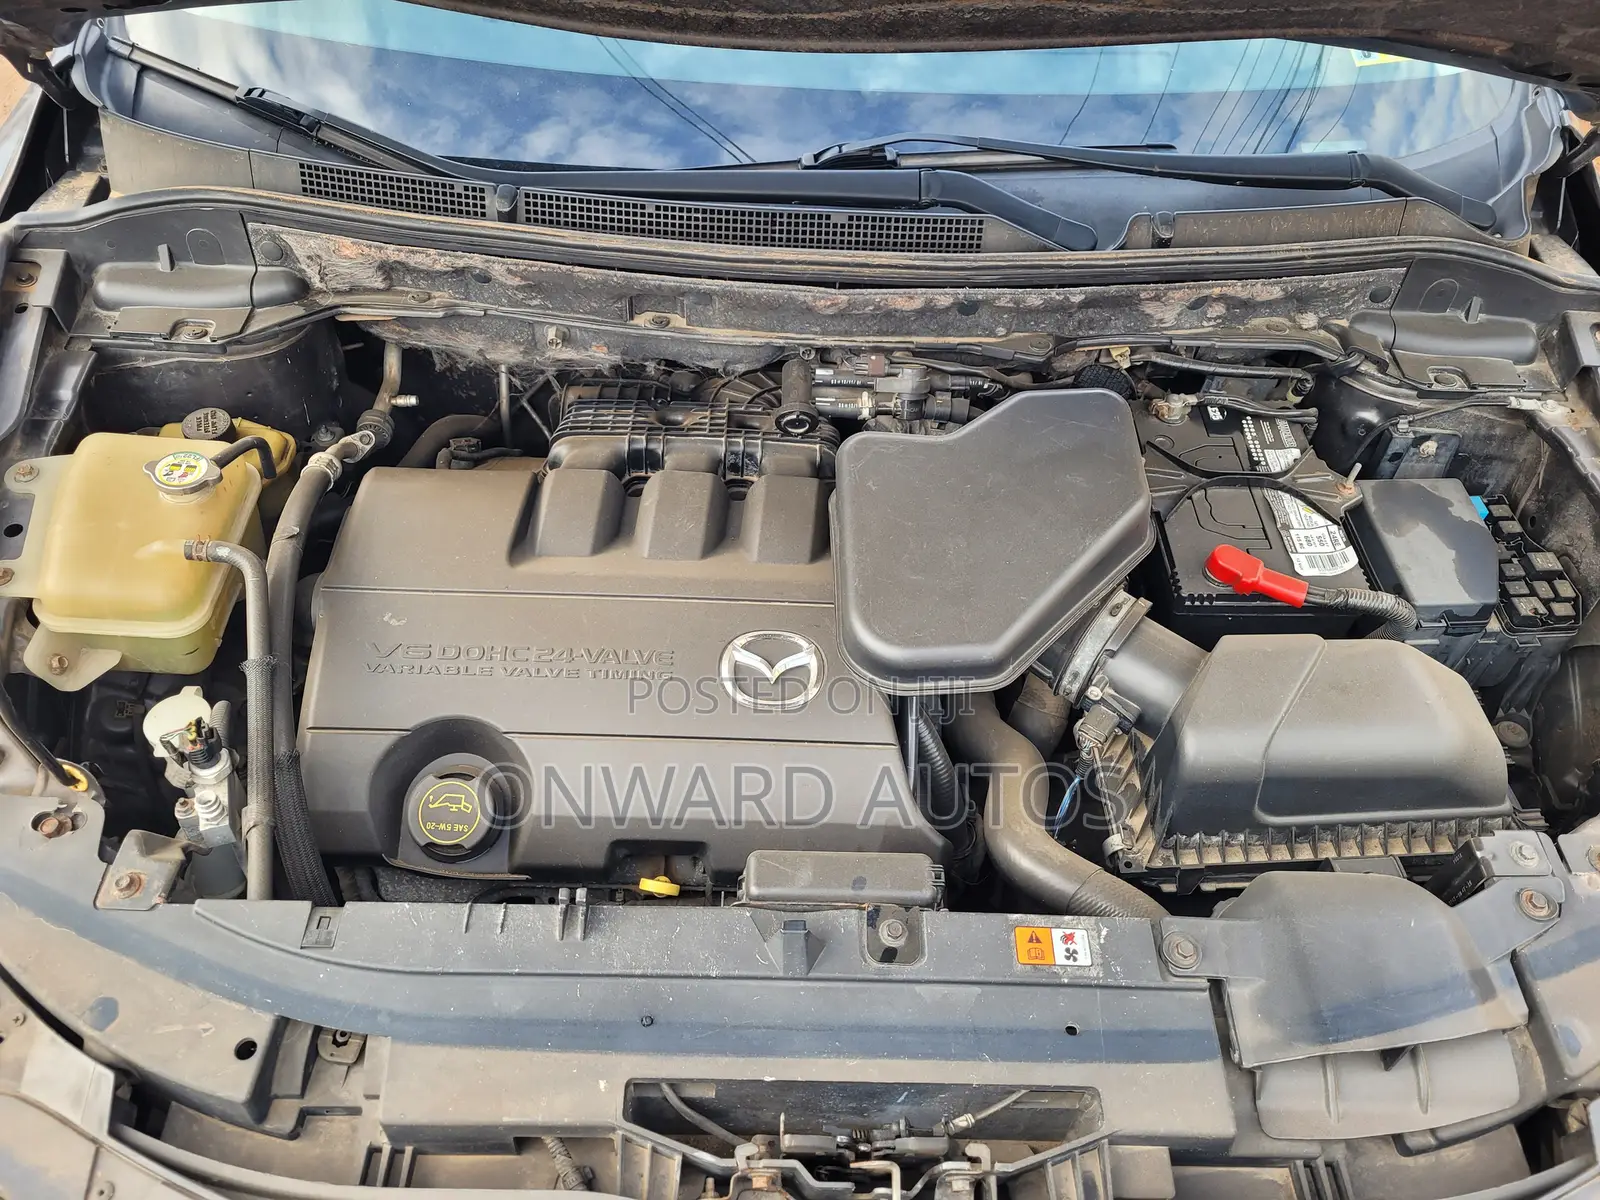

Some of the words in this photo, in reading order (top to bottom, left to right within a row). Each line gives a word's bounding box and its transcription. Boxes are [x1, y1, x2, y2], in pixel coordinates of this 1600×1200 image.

[1303, 535, 1312, 547] 680
[1315, 535, 1325, 547] 550
[437, 645, 531, 663] DOHC
[532, 647, 675, 666] 24-VALVE
[365, 662, 494, 677] VARIABLE
[500, 666, 580, 679] VALVE
[586, 668, 674, 681] TIMING
[426, 821, 452, 832] 5W-20
[453, 823, 469, 832] SAE
